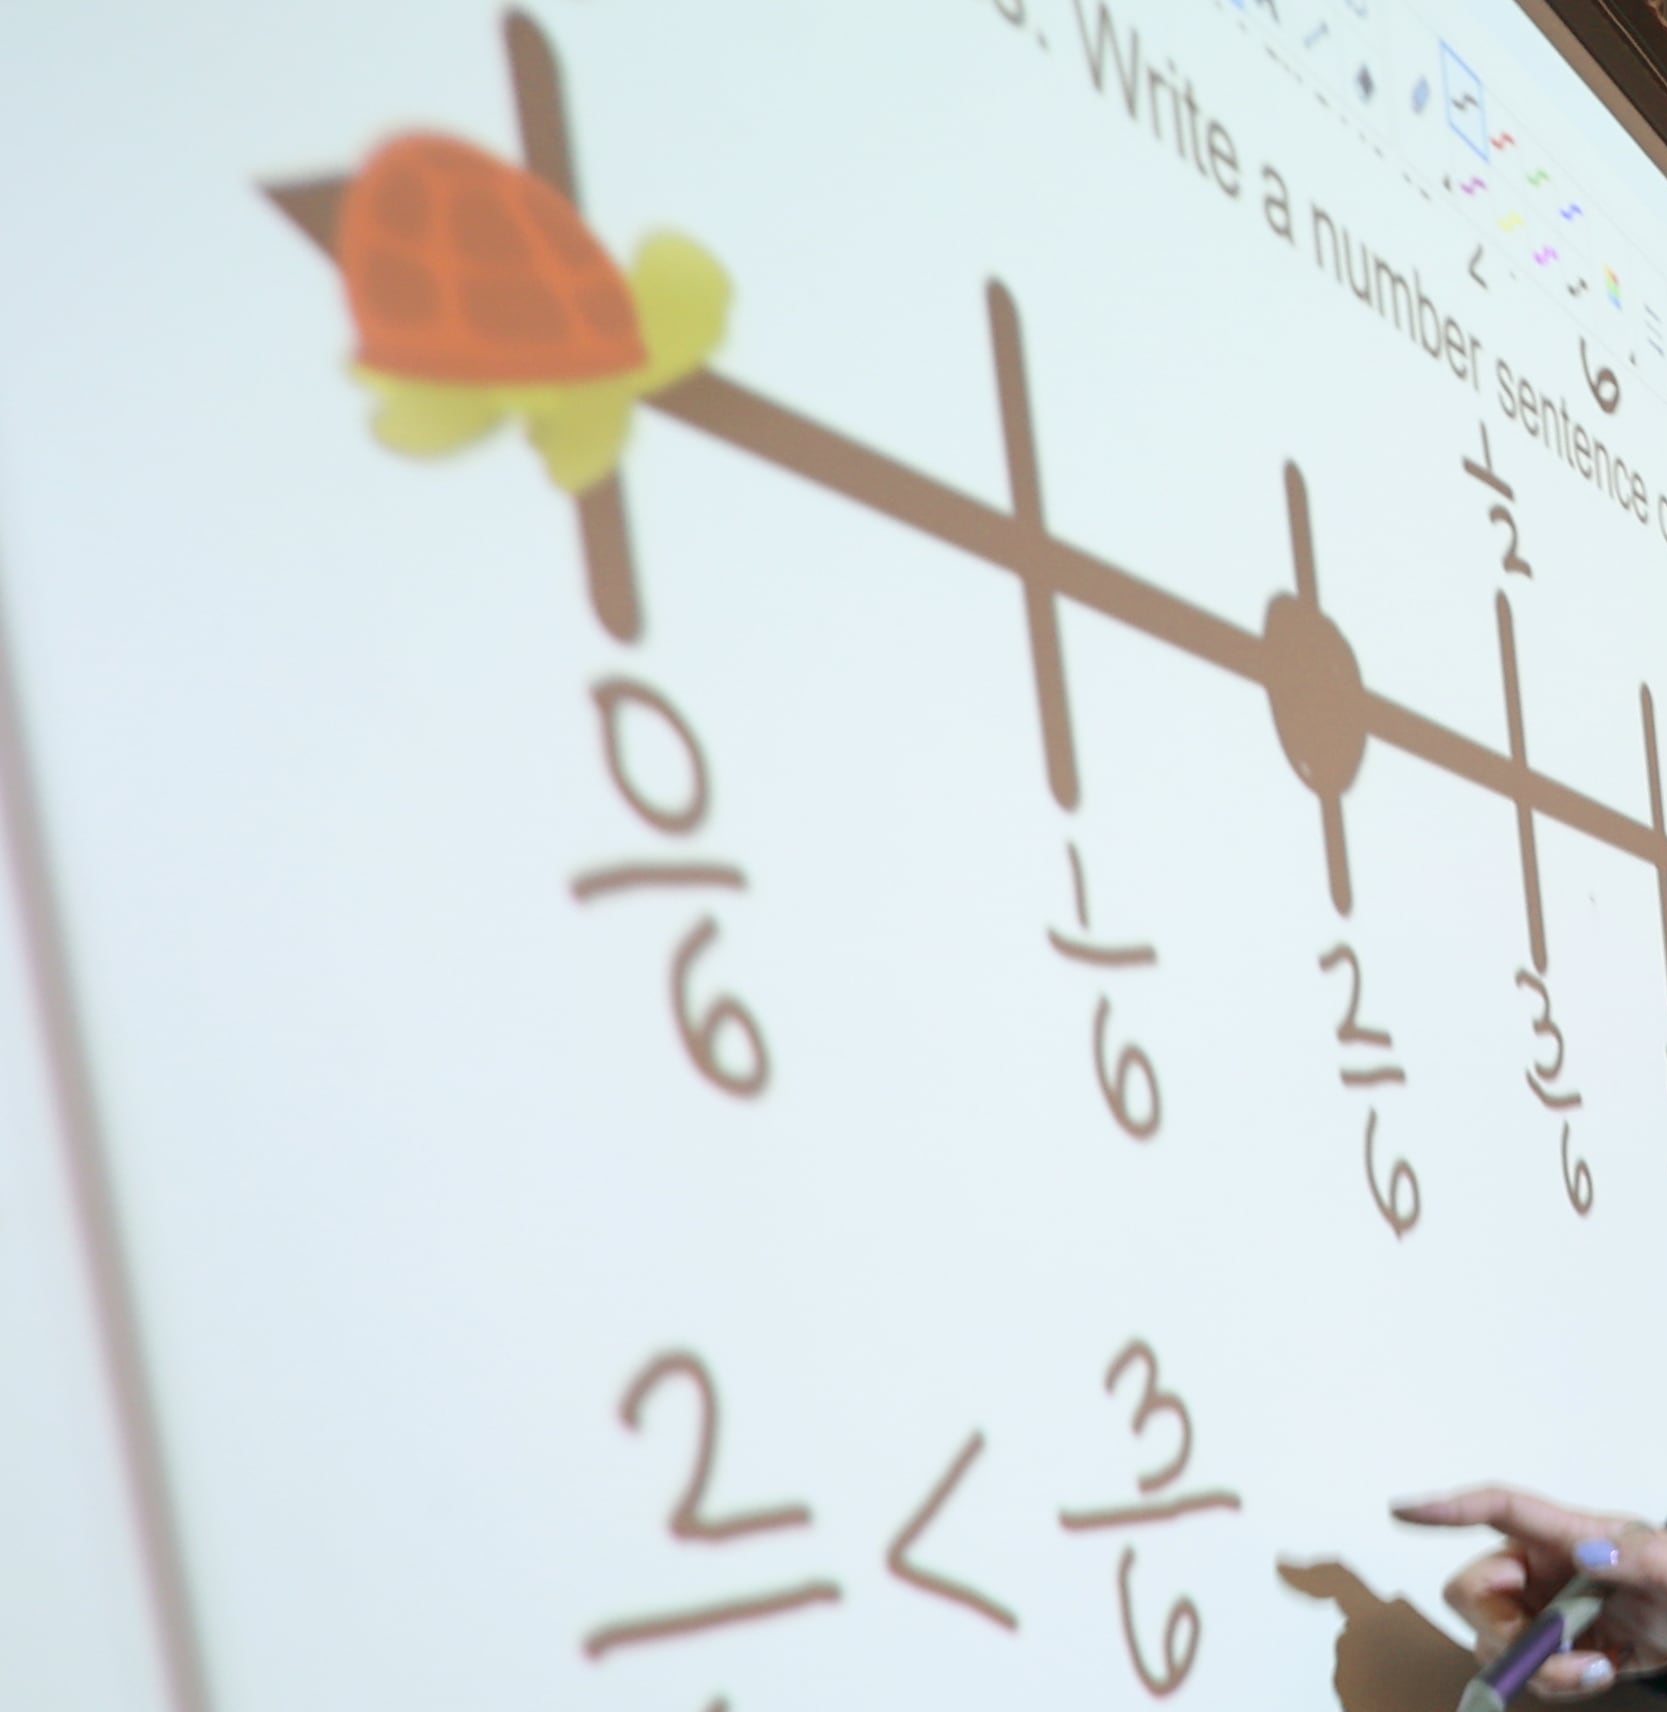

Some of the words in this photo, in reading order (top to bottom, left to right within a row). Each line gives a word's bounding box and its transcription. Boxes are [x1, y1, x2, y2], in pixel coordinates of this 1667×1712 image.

[1073, 0, 1241, 199] Write
[1260, 163, 1295, 246] a
[1311, 200, 1482, 392] number
[1496, 357, 1649, 525] sentence
[1489, 503, 1534, 580] 2
[588, 673, 710, 836] 0
[1066, 840, 1089, 930] 1
[669, 915, 770, 1099] 6
[1093, 993, 1162, 1142] 6
[1317, 942, 1393, 1048] 2
[1515, 967, 1565, 1082] 3
[1363, 1105, 1420, 1240] 6
[1560, 1118, 1594, 1217] 6
[617, 1345, 813, 1542] 2
[1103, 1337, 1193, 1496] 3
[1117, 1544, 1202, 1700] 6
